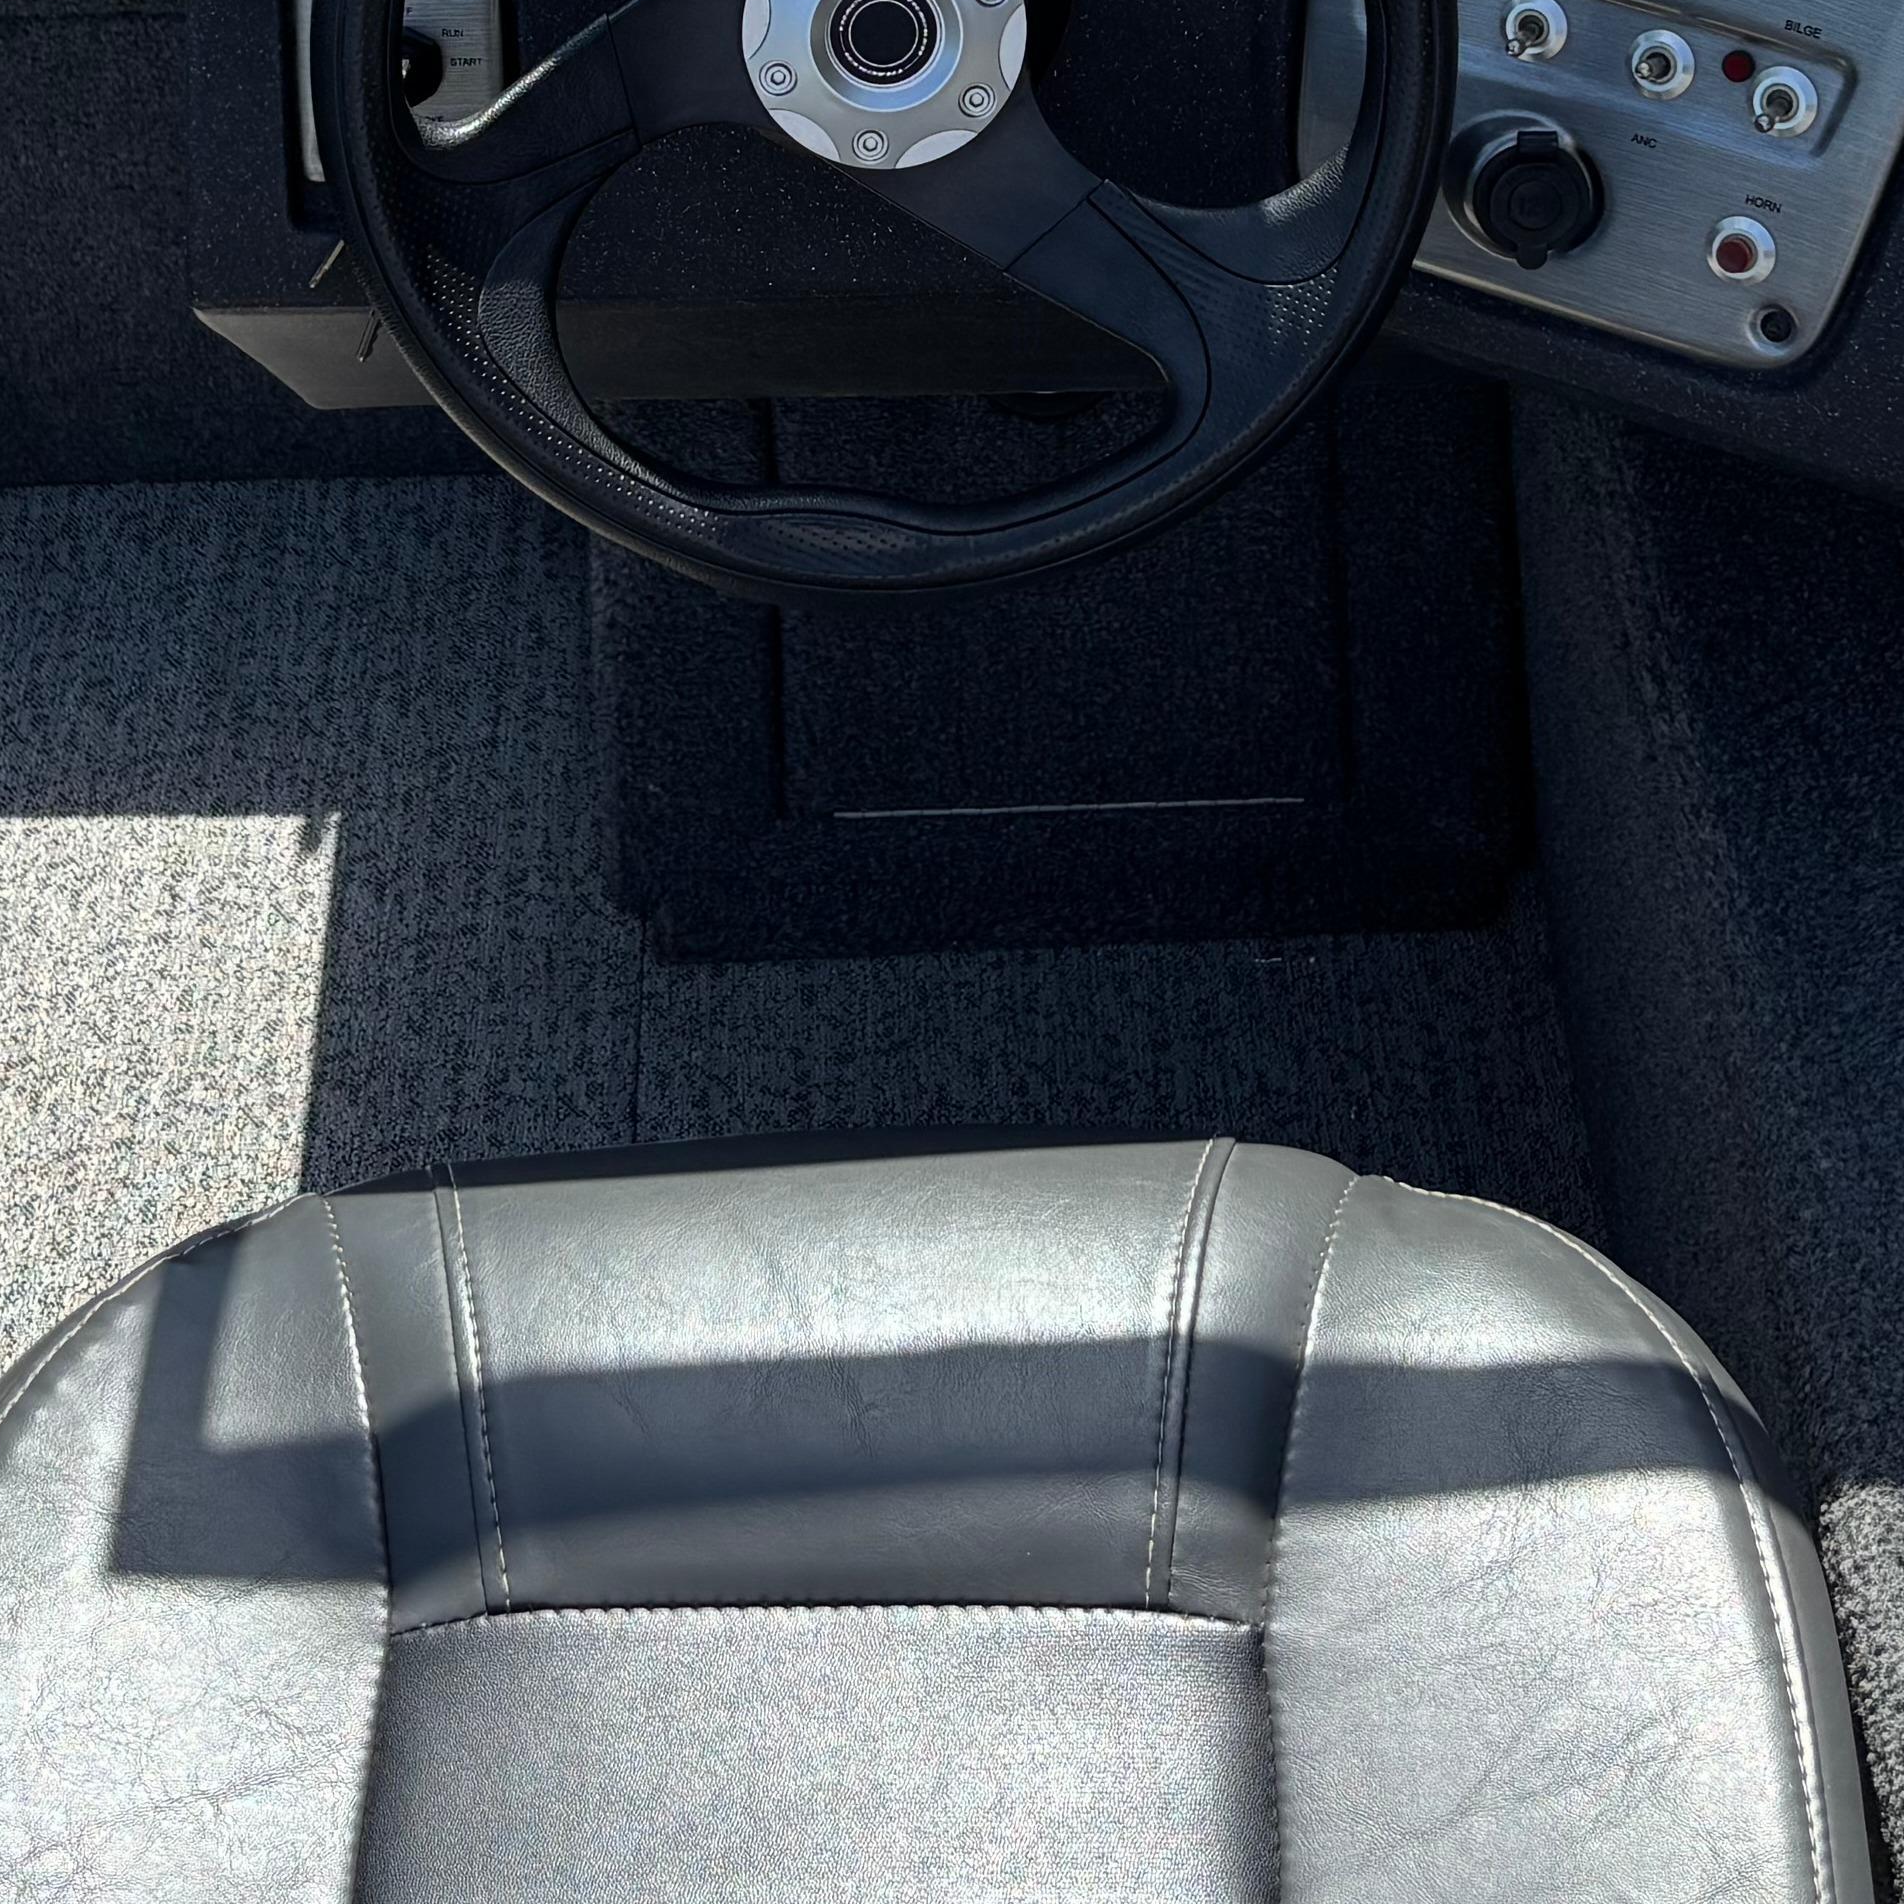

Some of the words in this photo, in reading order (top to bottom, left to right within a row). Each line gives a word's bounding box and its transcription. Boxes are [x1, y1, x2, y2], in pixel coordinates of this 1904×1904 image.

[441, 28, 464, 37] RUN
[1784, 19, 1823, 40] BILGE
[450, 57, 483, 67] START
[1630, 132, 1658, 150] ANC
[1745, 193, 1782, 214] HORN
